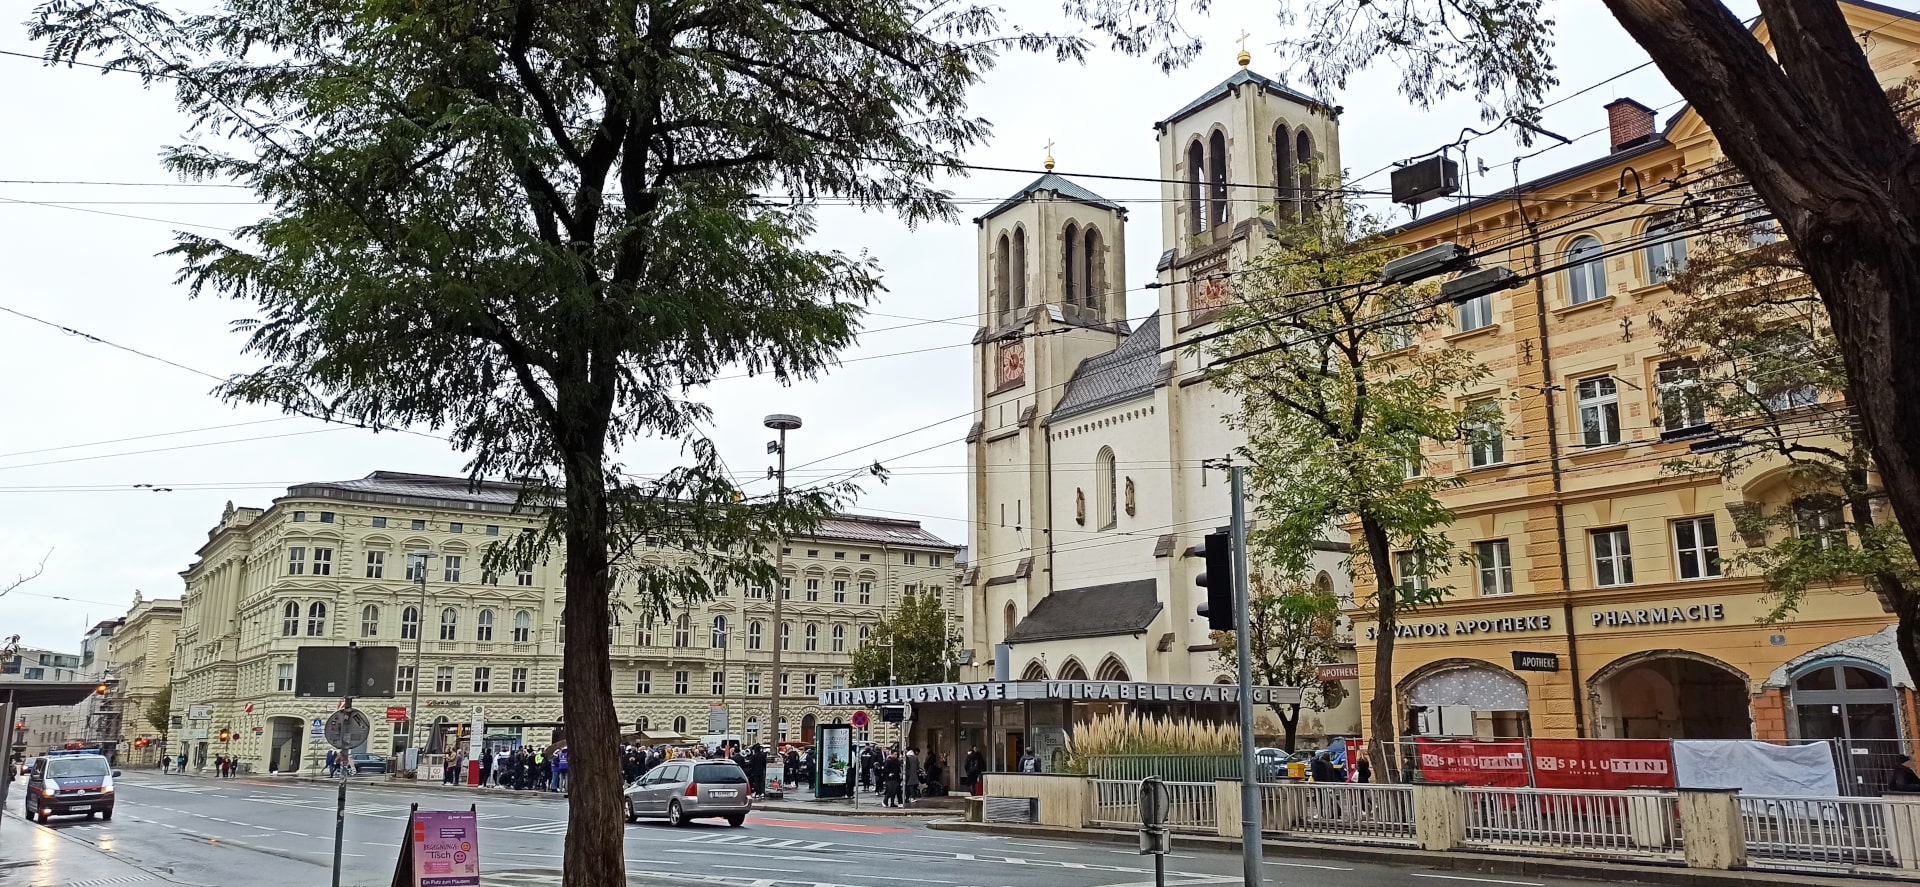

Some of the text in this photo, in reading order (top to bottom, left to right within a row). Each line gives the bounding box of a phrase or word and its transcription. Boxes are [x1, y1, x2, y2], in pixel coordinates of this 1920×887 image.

[1591, 603, 1724, 627] PHARMACIE
[1366, 615, 1550, 639] SVATOR APOTHEKE
[1522, 656, 1556, 669] APOTHEKE
[1321, 667, 1358, 678] APOTHEKE
[822, 683, 1006, 705] MIRABELLGARAGE
[1438, 756, 1521, 768] SPILUTTINI
[1558, 759, 1665, 771] SPILUTTINI
[431, 851, 451, 859] Tisch
